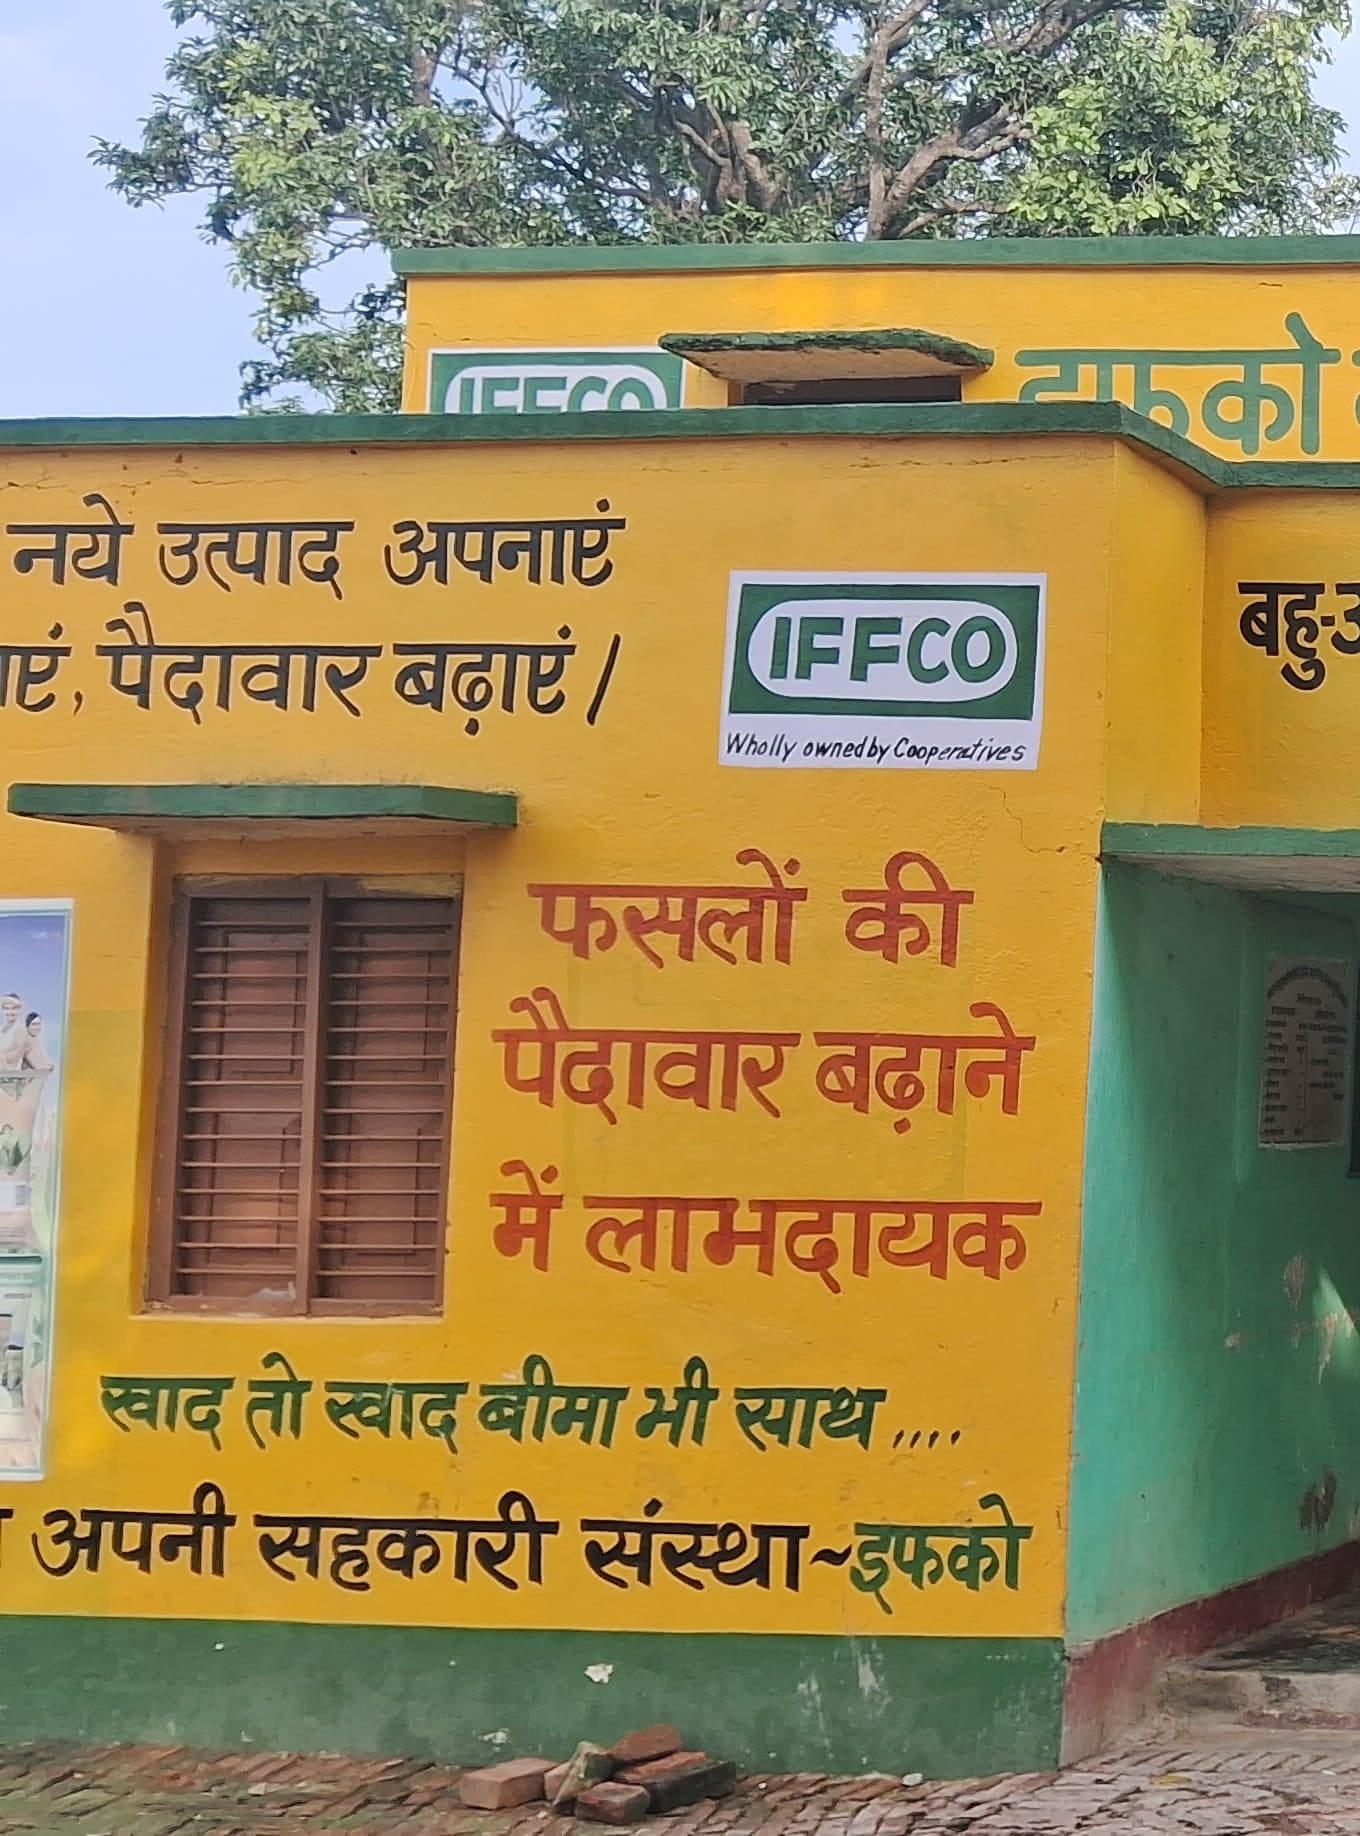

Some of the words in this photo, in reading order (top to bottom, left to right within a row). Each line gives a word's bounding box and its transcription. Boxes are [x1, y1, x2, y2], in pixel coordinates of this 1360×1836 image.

[6, 492, 135, 587] नये
[157, 519, 355, 600] उत्पाद
[384, 497, 626, 586] अपनाएं
[95, 600, 383, 725] पैदावार
[392, 624, 577, 736] बढ़ाएं
[768, 614, 1012, 686] IFFCO
[726, 731, 798, 763] Wholly
[801, 736, 870, 758] owned
[867, 737, 892, 764] by
[893, 737, 1028, 766] Cooperatives
[526, 847, 808, 969] फसलों
[840, 850, 975, 968] की
[490, 986, 801, 1126] पैदावार
[812, 1001, 1037, 1135] बढ़ाने
[488, 1158, 565, 1273] में
[581, 1194, 1043, 1295] लाभदायक
[246, 1350, 314, 1451] तो
[476, 1353, 631, 1449] बीमा
[634, 1355, 721, 1449] भी
[732, 1386, 889, 1452] साथ
[31, 1481, 238, 1578] अपनी
[253, 1489, 561, 1591] सहकारी
